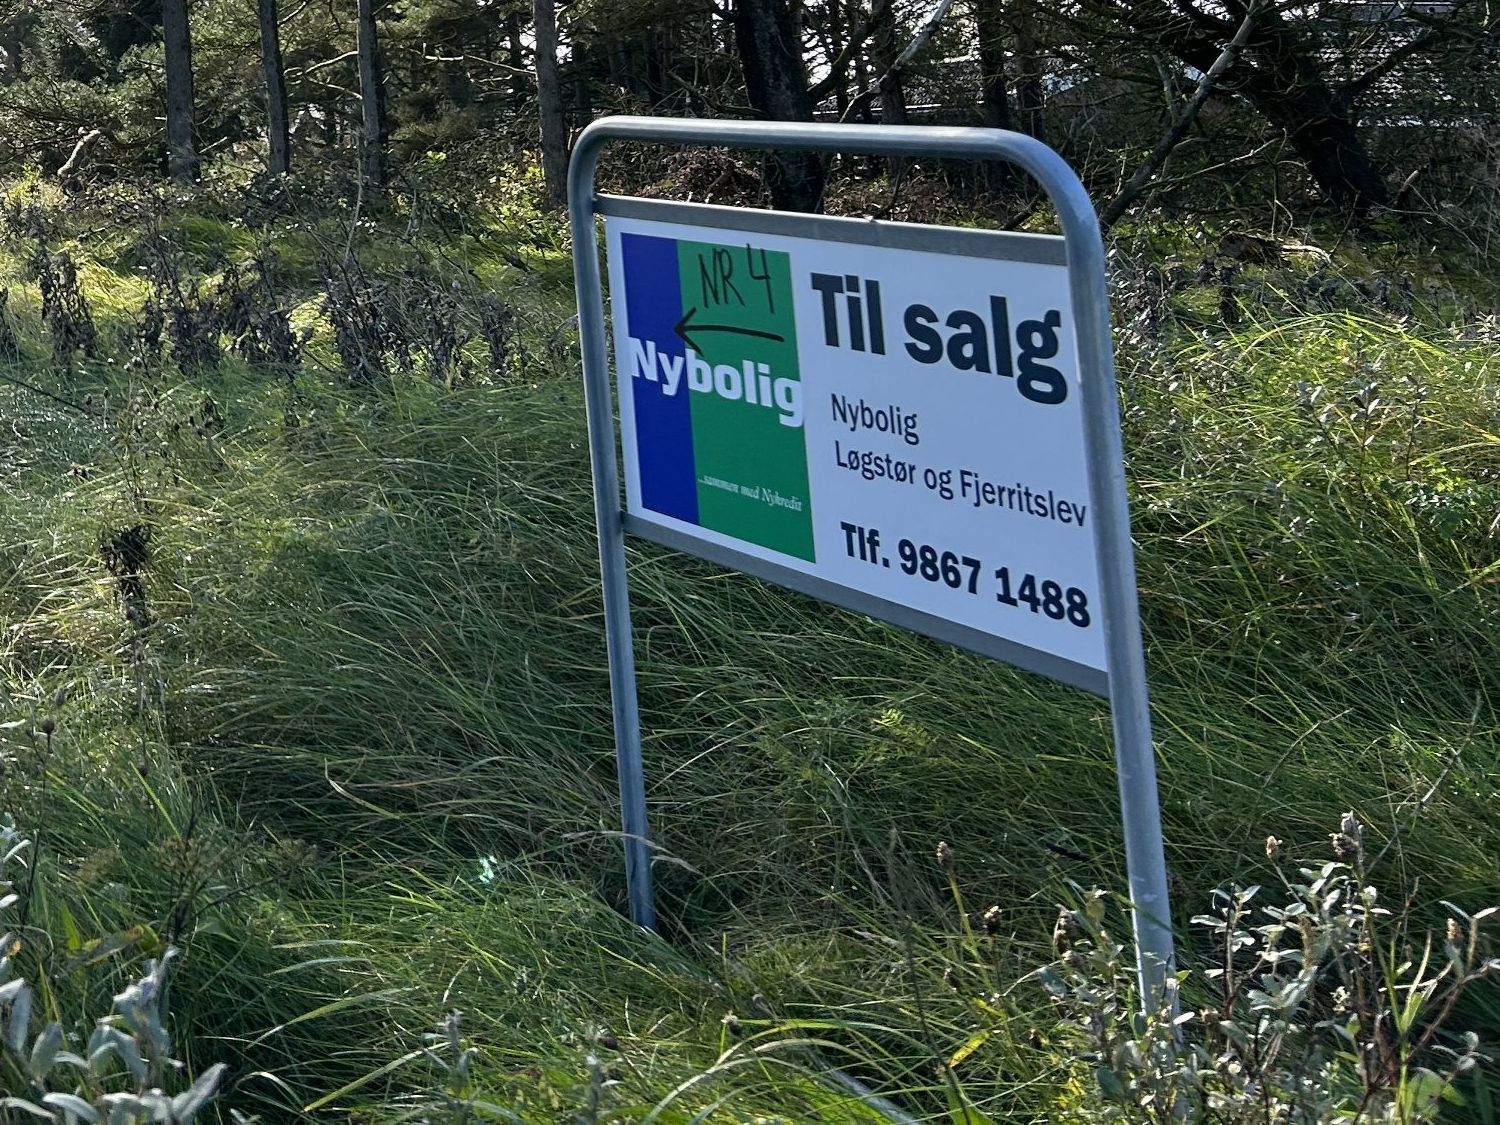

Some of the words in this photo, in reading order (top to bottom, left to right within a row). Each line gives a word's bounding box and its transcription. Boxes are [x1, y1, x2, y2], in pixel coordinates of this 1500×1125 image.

[698, 247, 746, 308] NR
[746, 243, 775, 314] 4
[628, 336, 804, 427] Nybolig
[811, 272, 885, 355] Til
[904, 295, 1067, 405] salg
[831, 393, 919, 445] Nybolig
[740, 486, 759, 499] med
[762, 487, 802, 511] Nykredit
[835, 440, 916, 485] Løgstør
[924, 468, 954, 500] og
[960, 469, 1086, 527] Fjerritslev
[840, 521, 890, 568] Tlf.
[898, 538, 981, 595] 9867
[995, 566, 1091, 627] 1488
